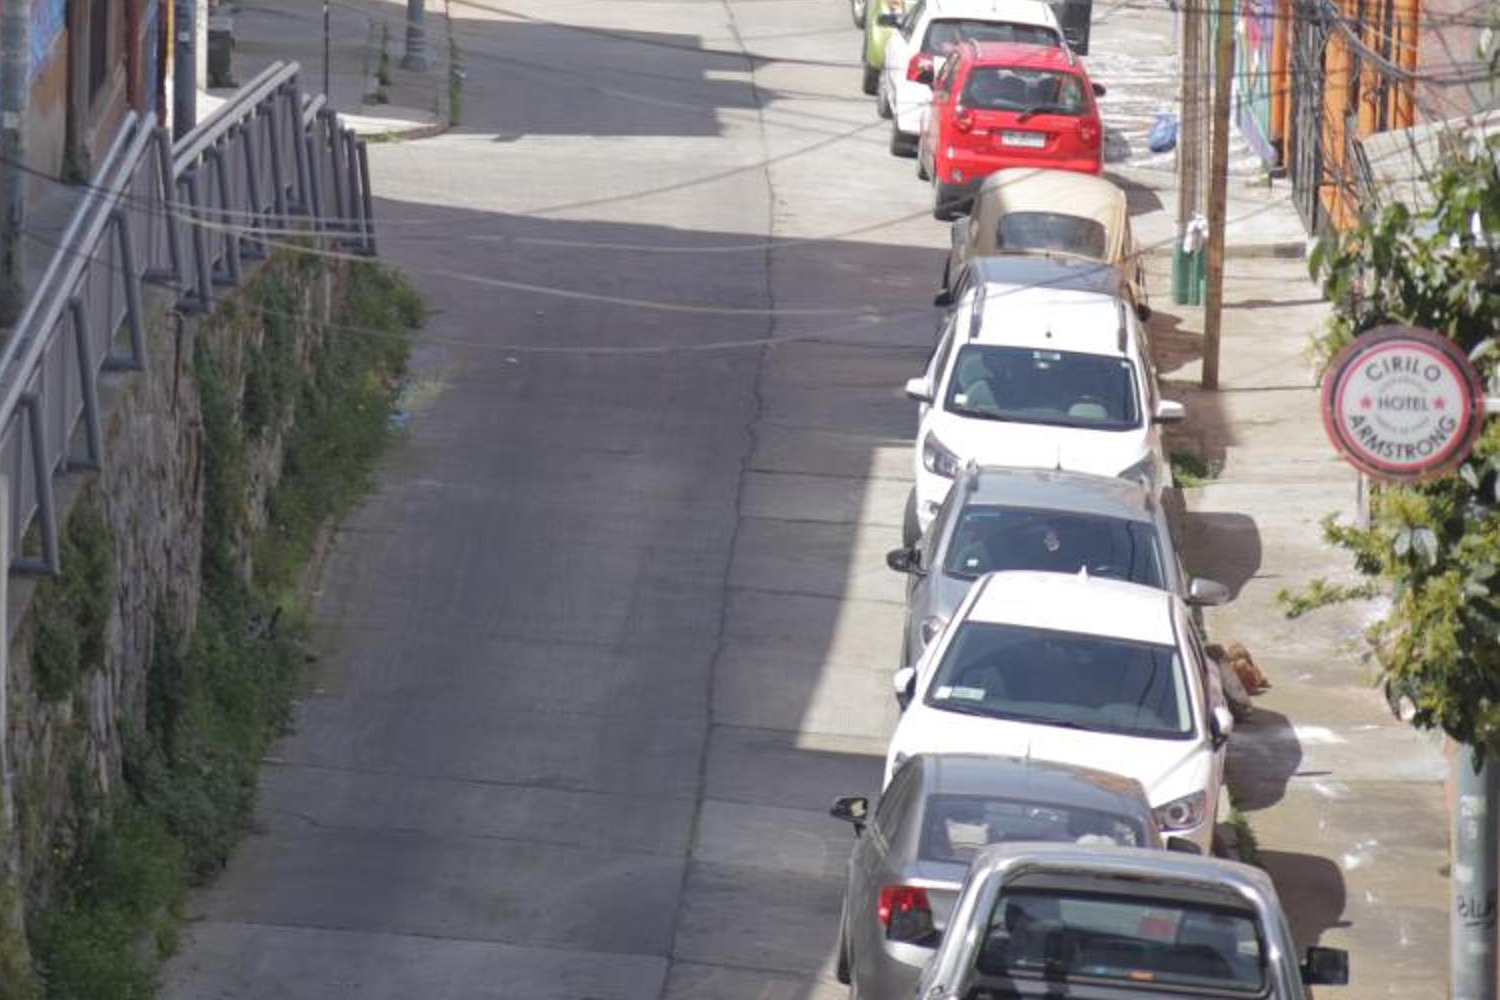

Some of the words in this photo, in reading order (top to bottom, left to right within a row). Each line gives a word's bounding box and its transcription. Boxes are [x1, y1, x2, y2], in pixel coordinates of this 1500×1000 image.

[1365, 356, 1441, 381] CIRILO
[1378, 398, 1428, 411] HOTEL
[1350, 415, 1456, 459] ARMSTRONG
